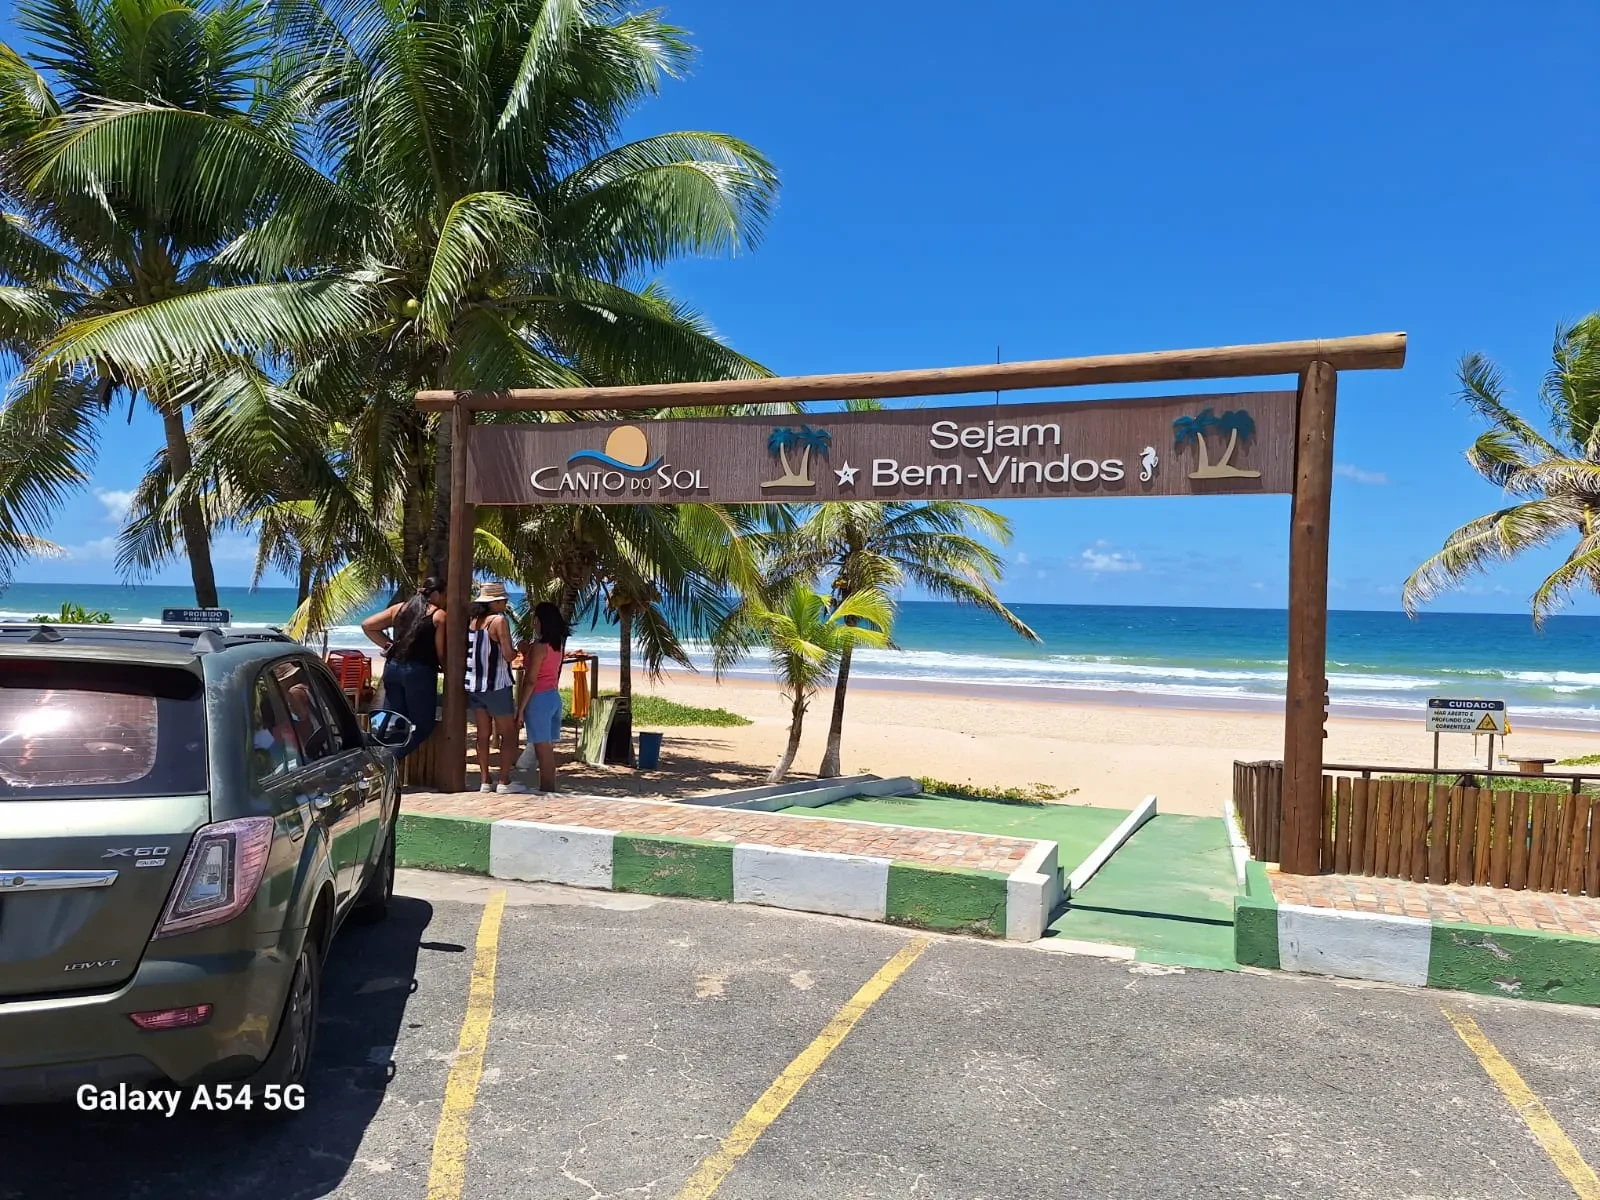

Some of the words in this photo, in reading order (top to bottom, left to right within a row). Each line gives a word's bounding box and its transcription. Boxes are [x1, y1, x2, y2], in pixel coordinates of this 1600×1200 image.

[929, 420, 1061, 454] Sejam
[530, 465, 625, 491] CANTO
[630, 477, 651, 490] DO
[656, 464, 709, 490] SOL
[872, 453, 1125, 487] Bem-Vindos
[183, 610, 223, 618] PROIBIDO
[1448, 701, 1496, 709] CUIDADO
[101, 846, 171, 858] X60
